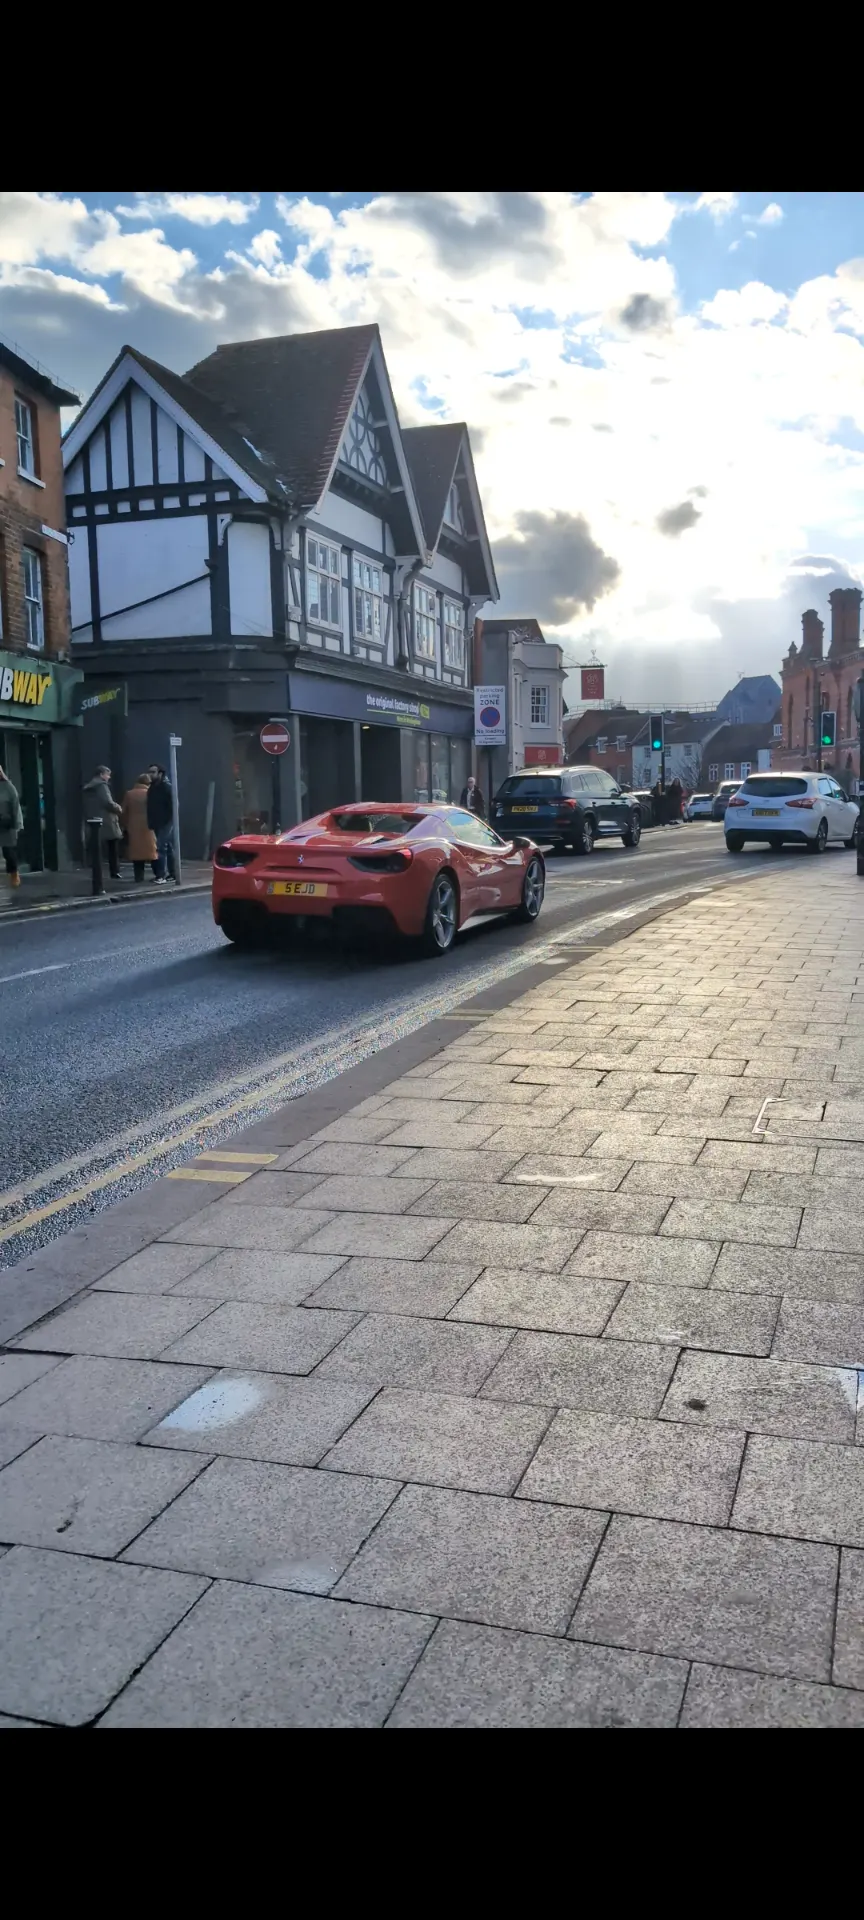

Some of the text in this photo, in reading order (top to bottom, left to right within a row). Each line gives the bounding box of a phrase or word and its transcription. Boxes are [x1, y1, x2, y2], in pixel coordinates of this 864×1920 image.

[81, 687, 121, 710] SUBWAY
[366, 694, 376, 706] the
[375, 696, 395, 710] original
[394, 699, 409, 714] factory
[409, 702, 420, 715] shop
[294, 883, 316, 894] EJD
